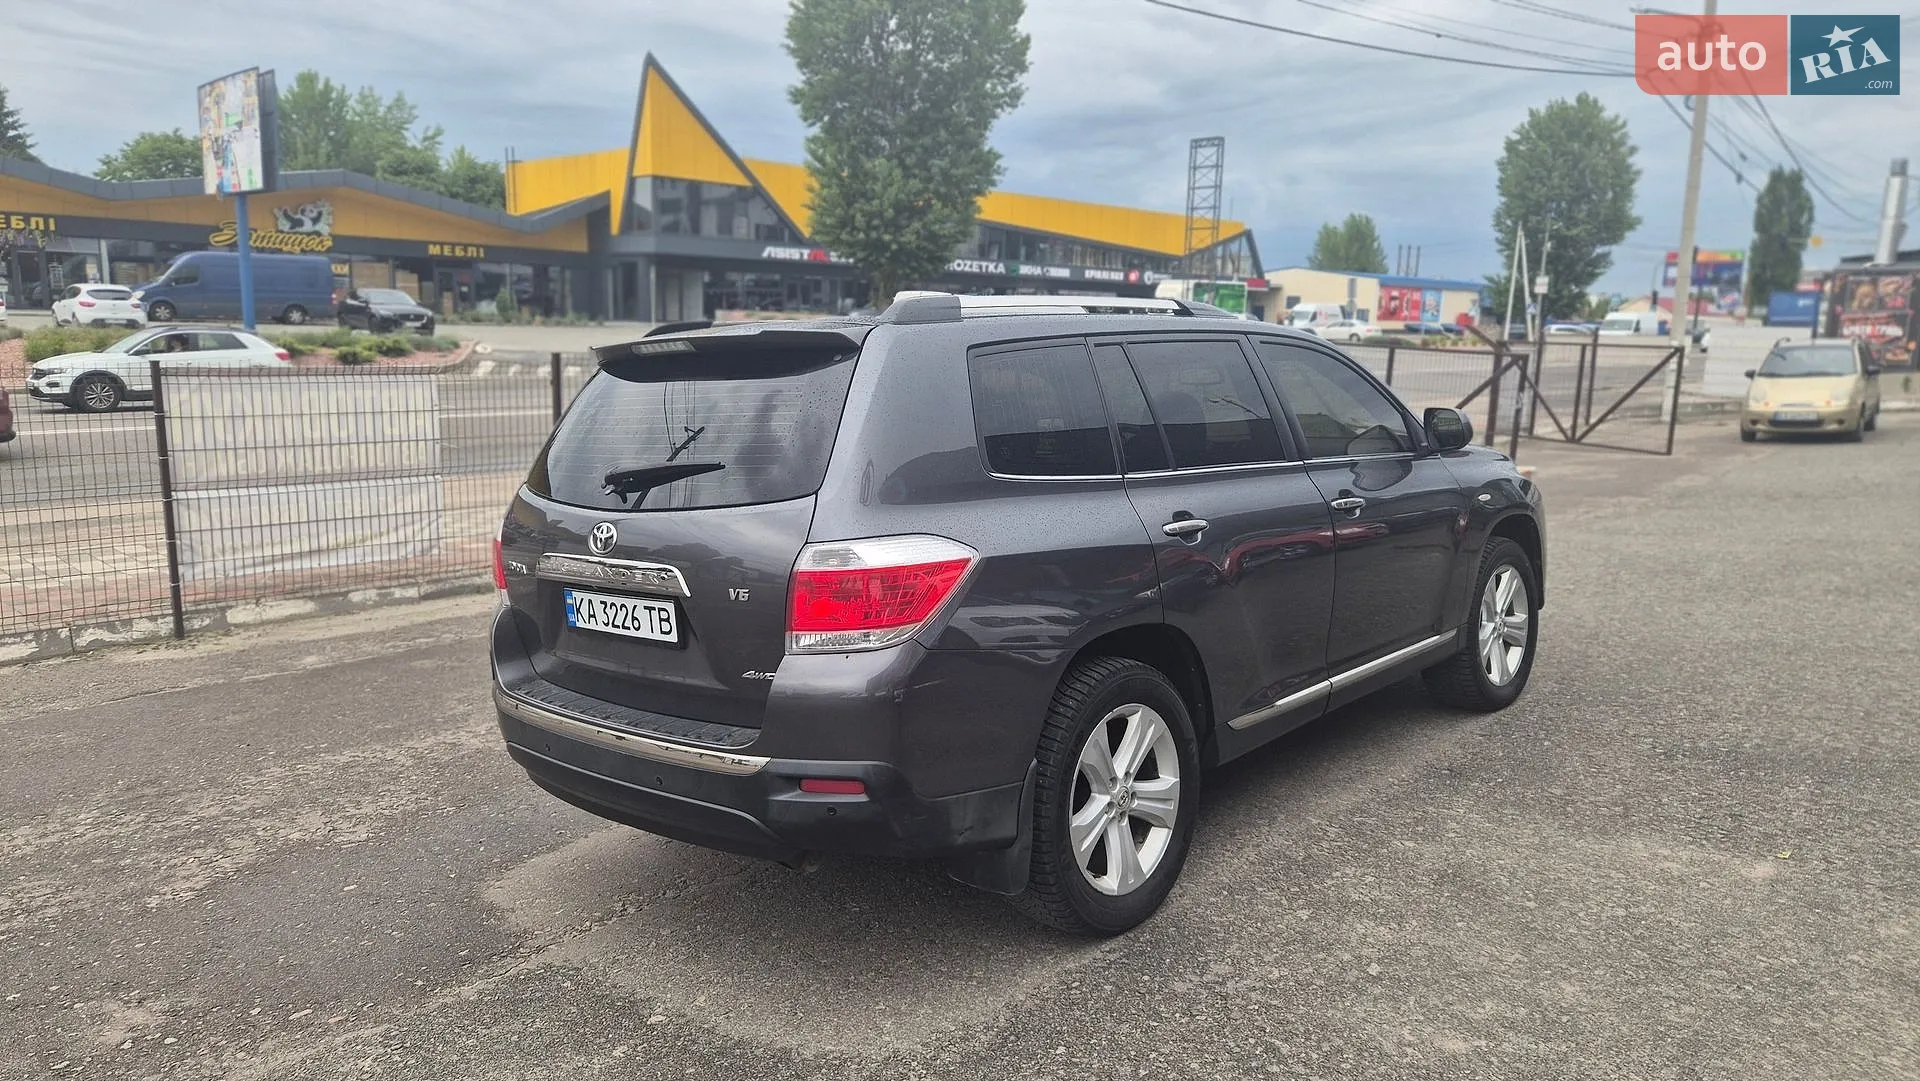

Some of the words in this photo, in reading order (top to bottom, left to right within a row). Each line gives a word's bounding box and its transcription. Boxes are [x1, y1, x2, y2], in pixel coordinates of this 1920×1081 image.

[728, 588, 750, 601] V6
[574, 596, 599, 626] KA
[600, 601, 641, 632] 3226
[644, 606, 673, 635] TB
